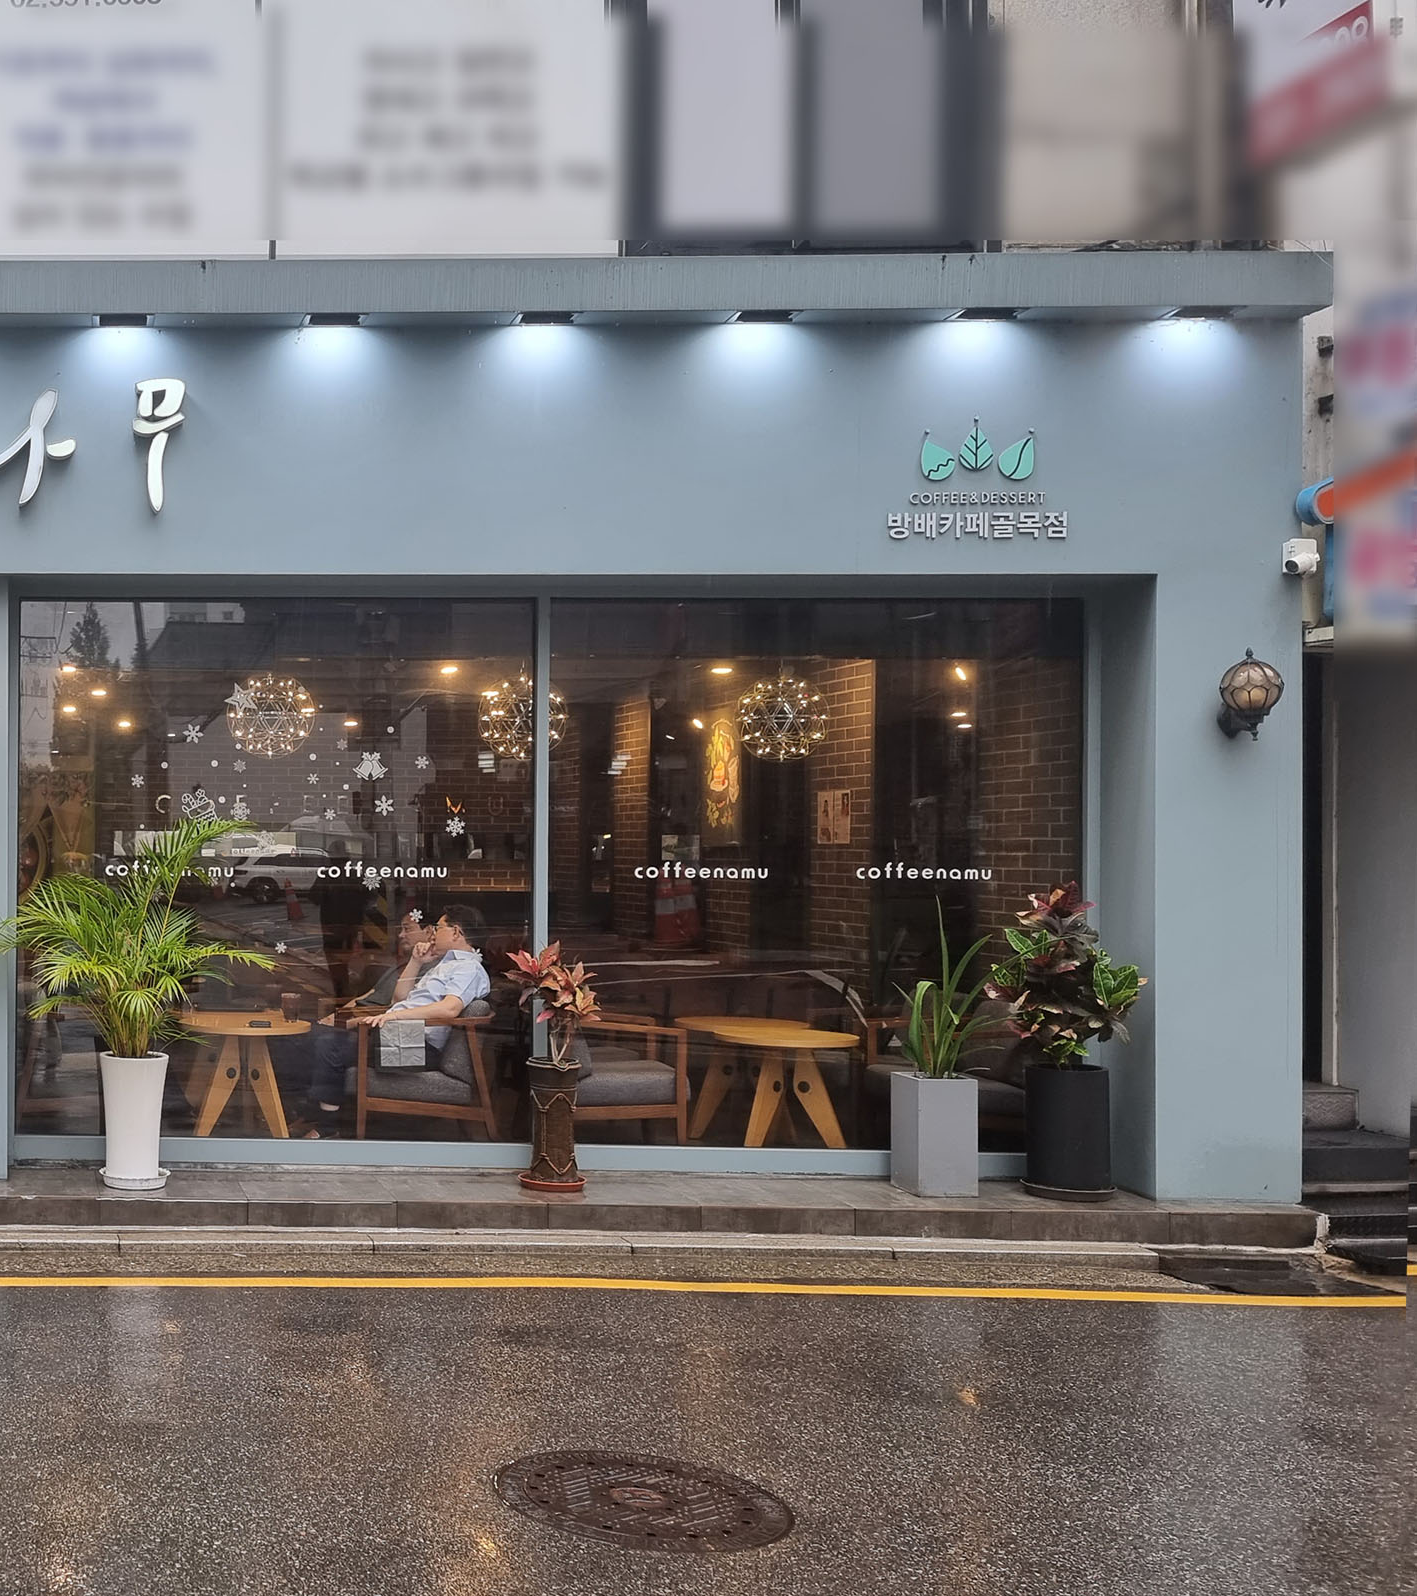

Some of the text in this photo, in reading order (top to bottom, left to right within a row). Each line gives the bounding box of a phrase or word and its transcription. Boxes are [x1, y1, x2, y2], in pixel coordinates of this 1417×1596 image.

[909, 491, 1047, 505] COFFEE&DESSERT
[886, 511, 1069, 540] 방배카페골목점
[316, 862, 449, 880] coffeenamu
[634, 861, 770, 880] coffeenamu
[855, 861, 993, 881] coffeenamu
